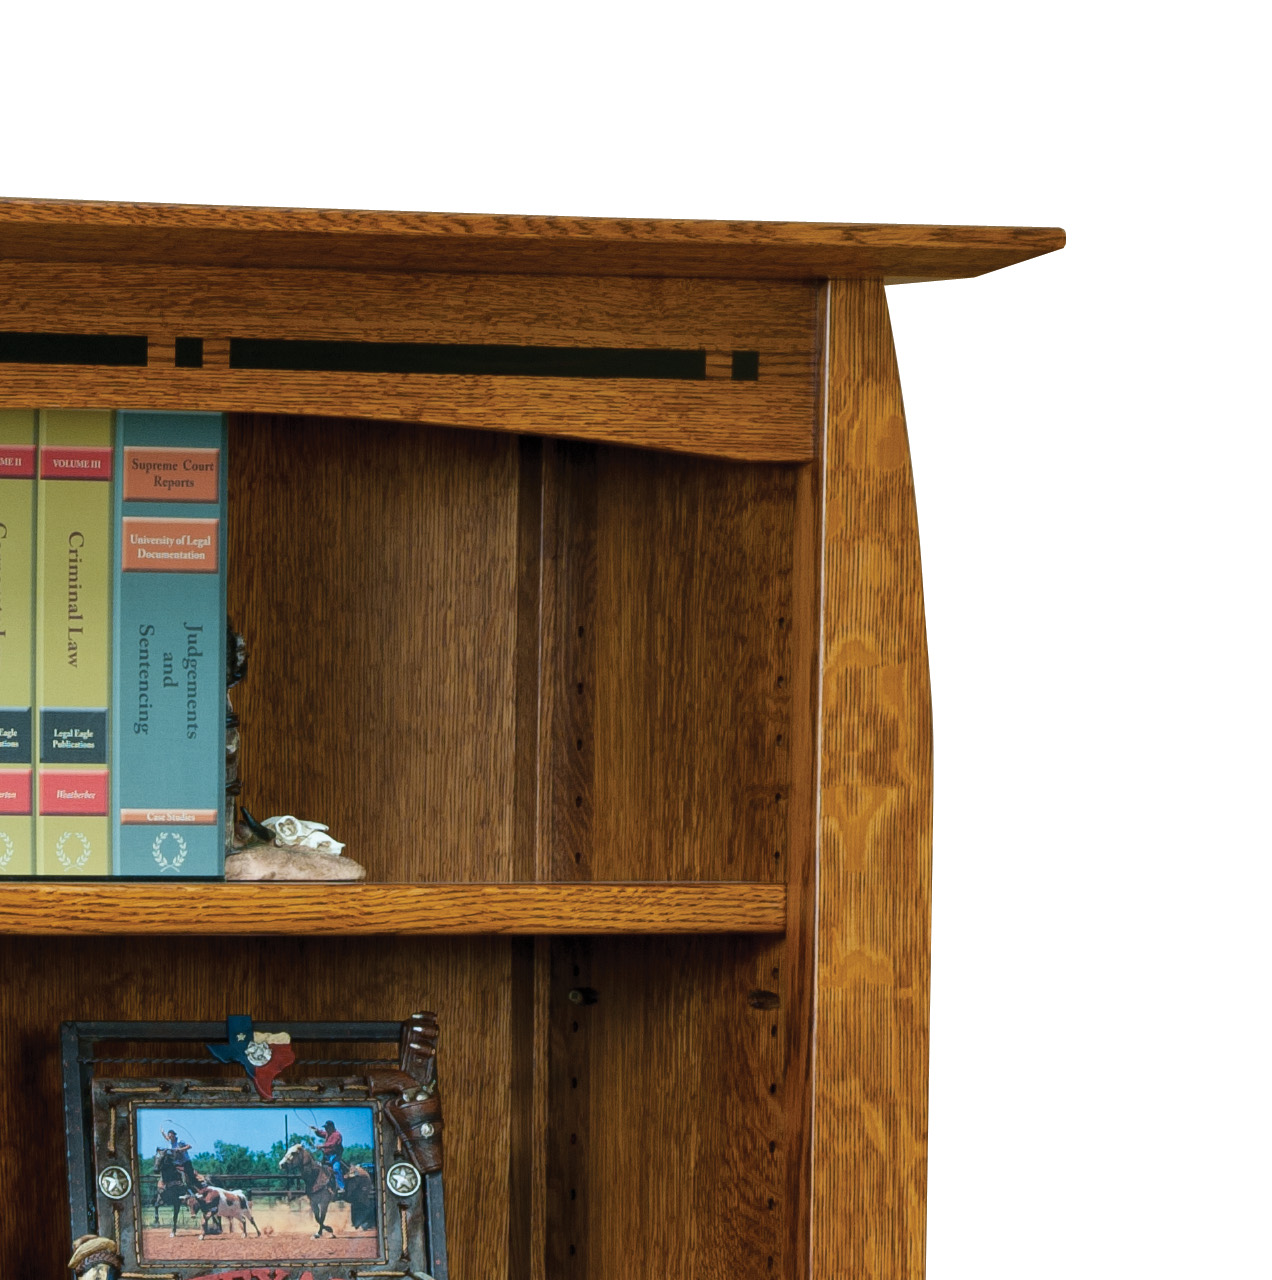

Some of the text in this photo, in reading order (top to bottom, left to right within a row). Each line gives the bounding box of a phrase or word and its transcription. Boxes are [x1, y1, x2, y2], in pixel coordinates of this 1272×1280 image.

[14, 458, 22, 467] II
[53, 459, 101, 469] VOLUME III
[131, 460, 214, 473] Supreme Court
[153, 475, 195, 490] Reports
[130, 535, 211, 548] University of Legal
[137, 550, 205, 560] Documentation
[67, 531, 84, 668] Criminal Law
[163, 652, 178, 688] and
[133, 624, 155, 735] Sentencing
[182, 622, 203, 739] Judgements
[54, 729, 93, 739] Legal Eagle
[53, 740, 95, 749] Publications
[146, 813, 195, 822] Case Studies
